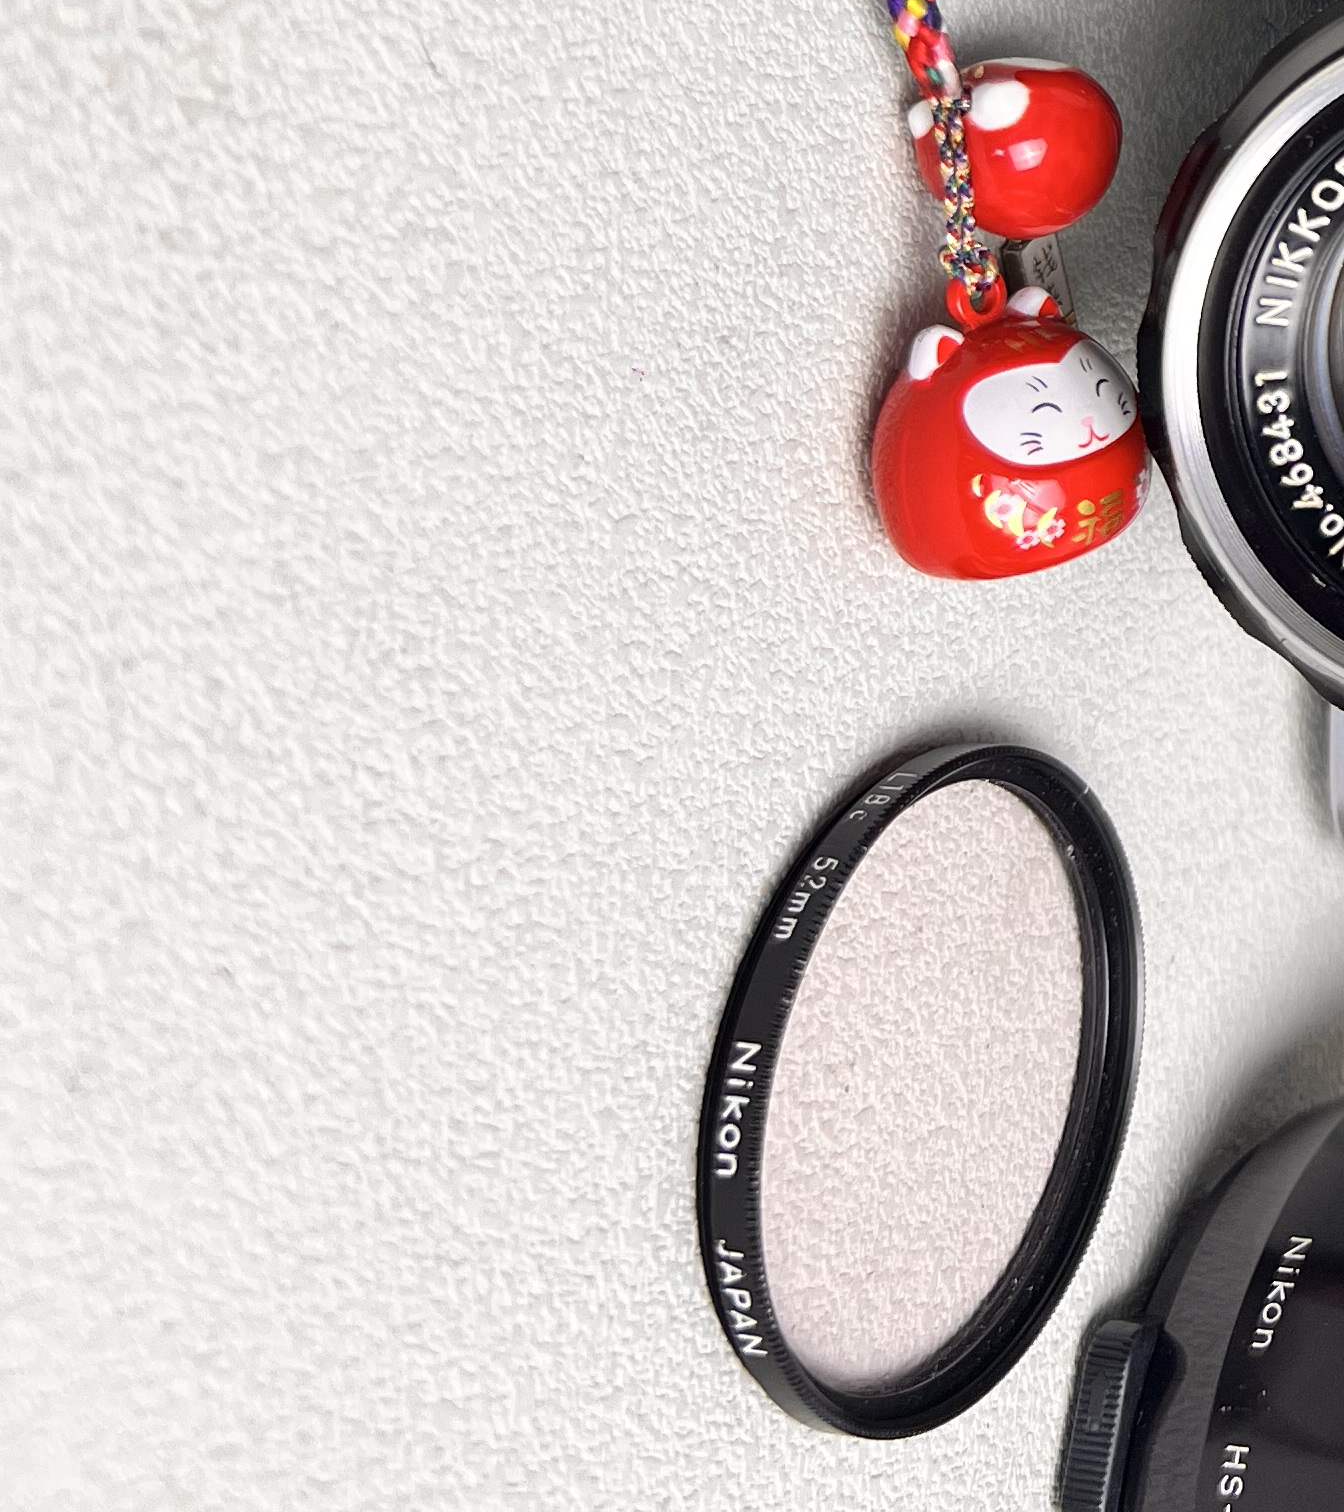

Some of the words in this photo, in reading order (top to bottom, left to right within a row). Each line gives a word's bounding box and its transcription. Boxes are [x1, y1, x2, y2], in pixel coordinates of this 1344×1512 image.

[773, 855, 840, 941] 52mm
[713, 1039, 763, 1181] Nikon
[712, 1238, 770, 1358] JAPAN
[1249, 1235, 1314, 1351] Nikon
